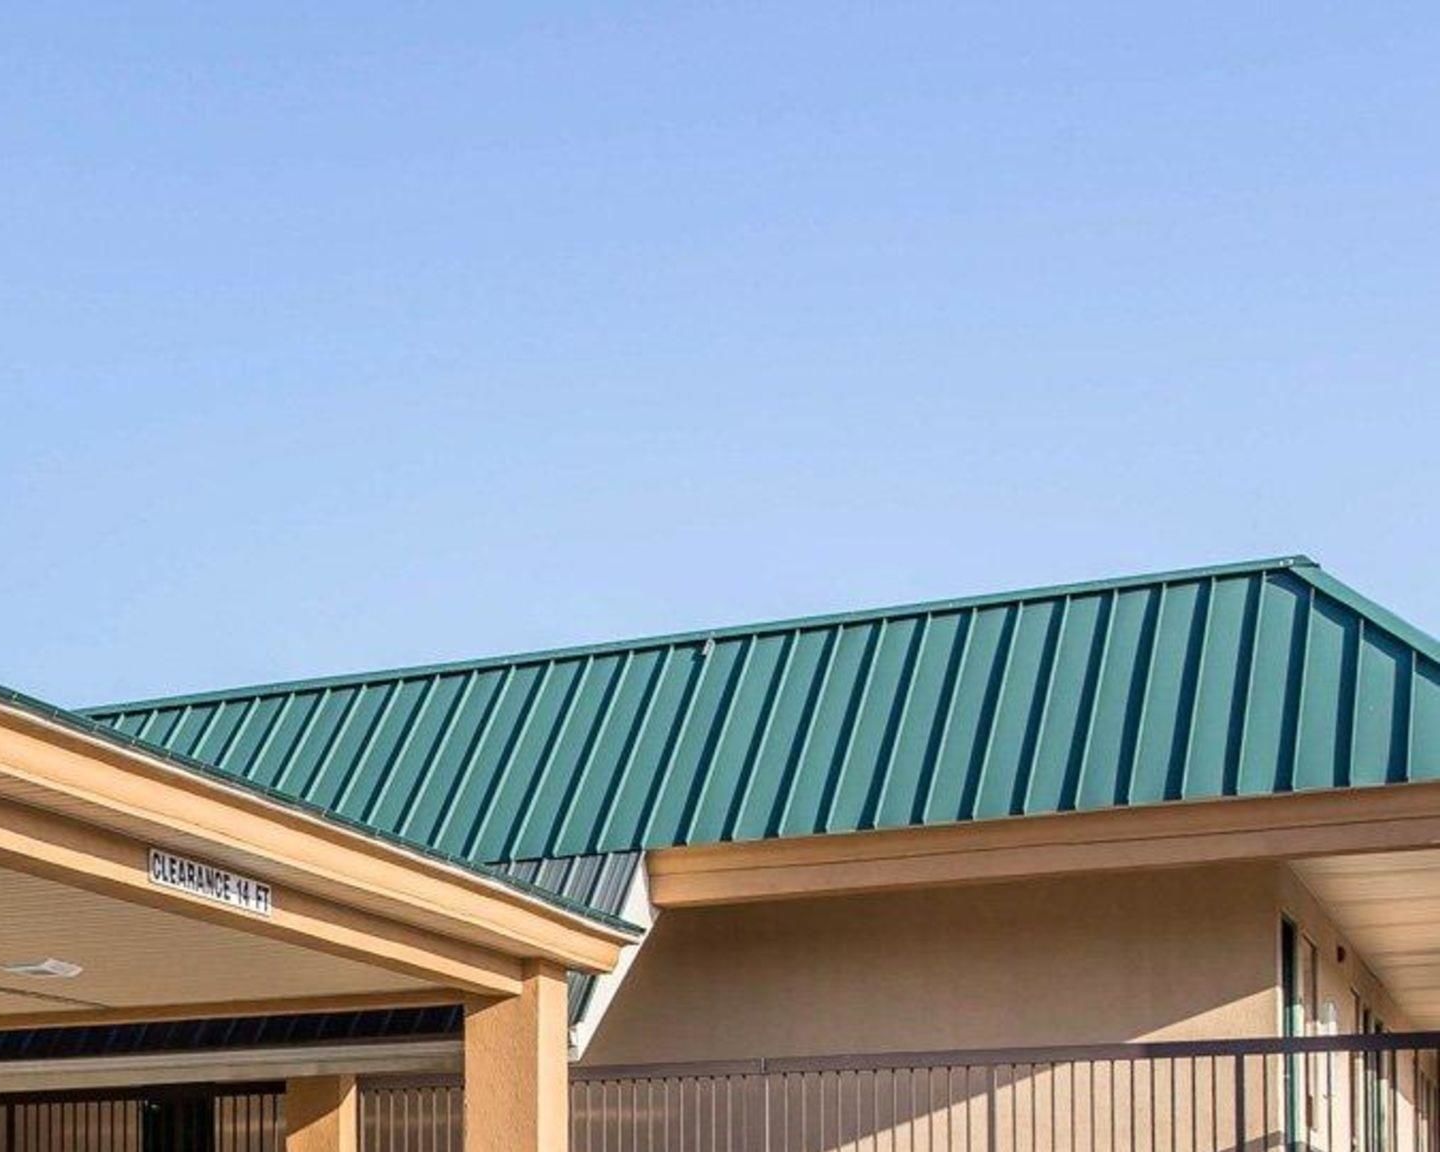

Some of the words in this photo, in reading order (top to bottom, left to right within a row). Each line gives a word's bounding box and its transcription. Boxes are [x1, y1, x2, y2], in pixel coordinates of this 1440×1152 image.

[153, 852, 231, 900] CLEARANCE
[237, 879, 249, 906] 14
[256, 884, 269, 911] FT
